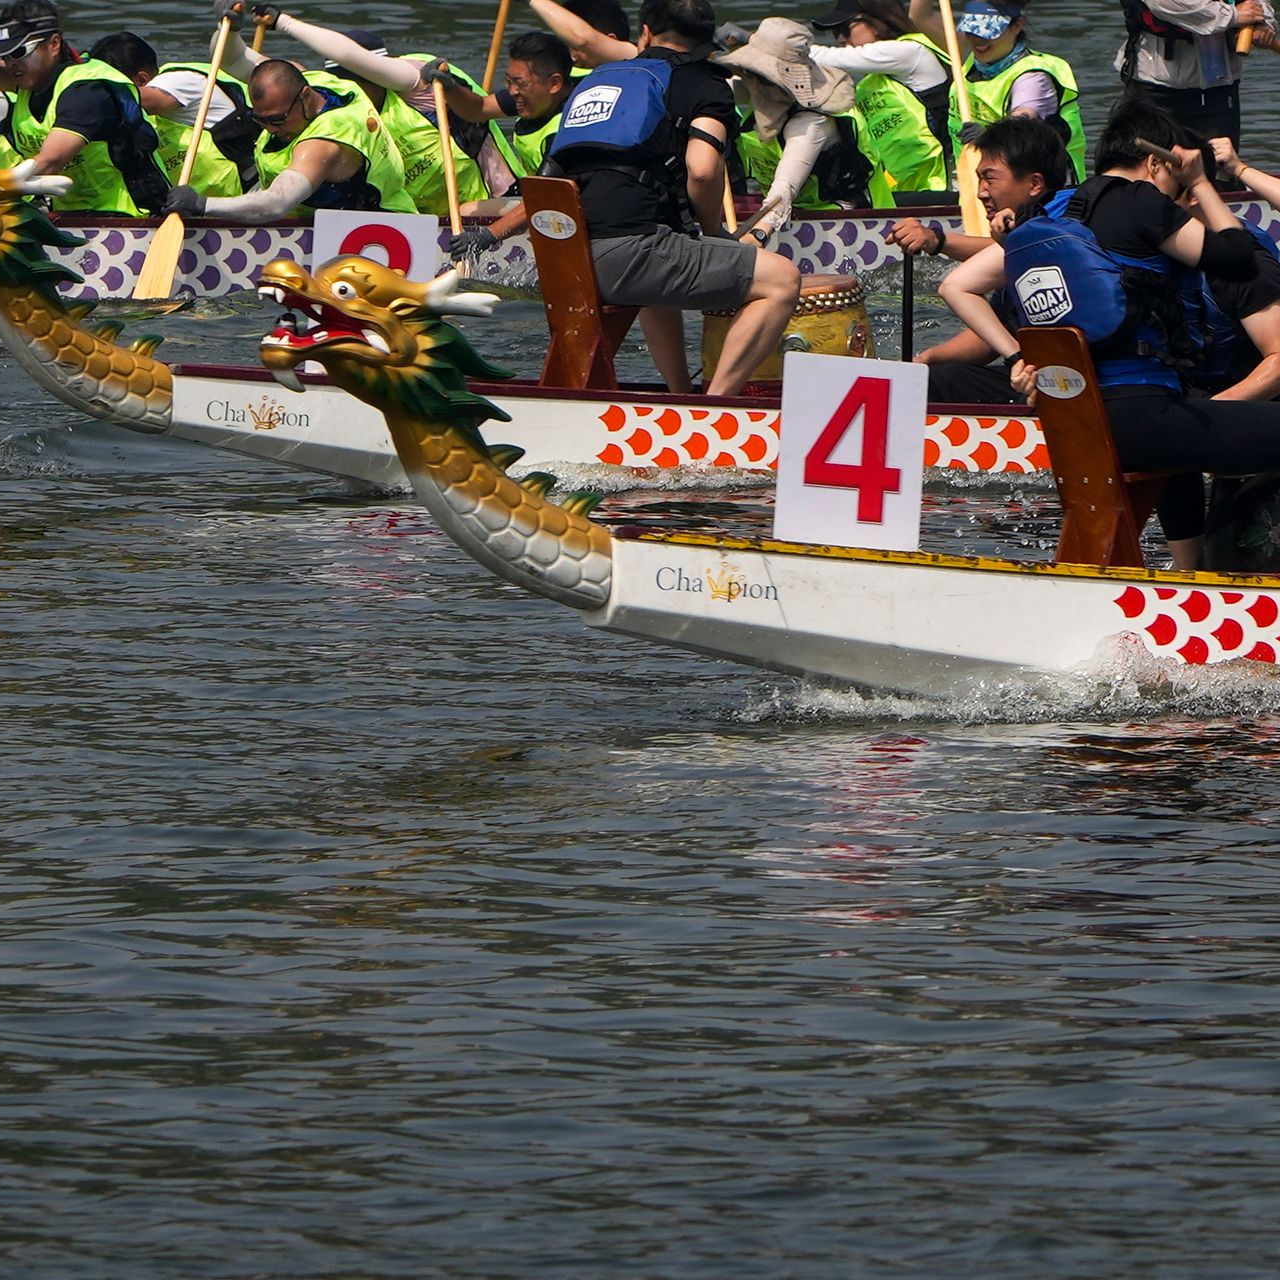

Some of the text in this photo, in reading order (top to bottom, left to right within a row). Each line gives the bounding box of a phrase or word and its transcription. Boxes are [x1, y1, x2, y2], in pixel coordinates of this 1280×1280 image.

[570, 101, 613, 119] TODAY
[1024, 288, 1065, 315] TODAY
[1029, 300, 1069, 322] SPORTS BASE
[804, 376, 901, 524] 4
